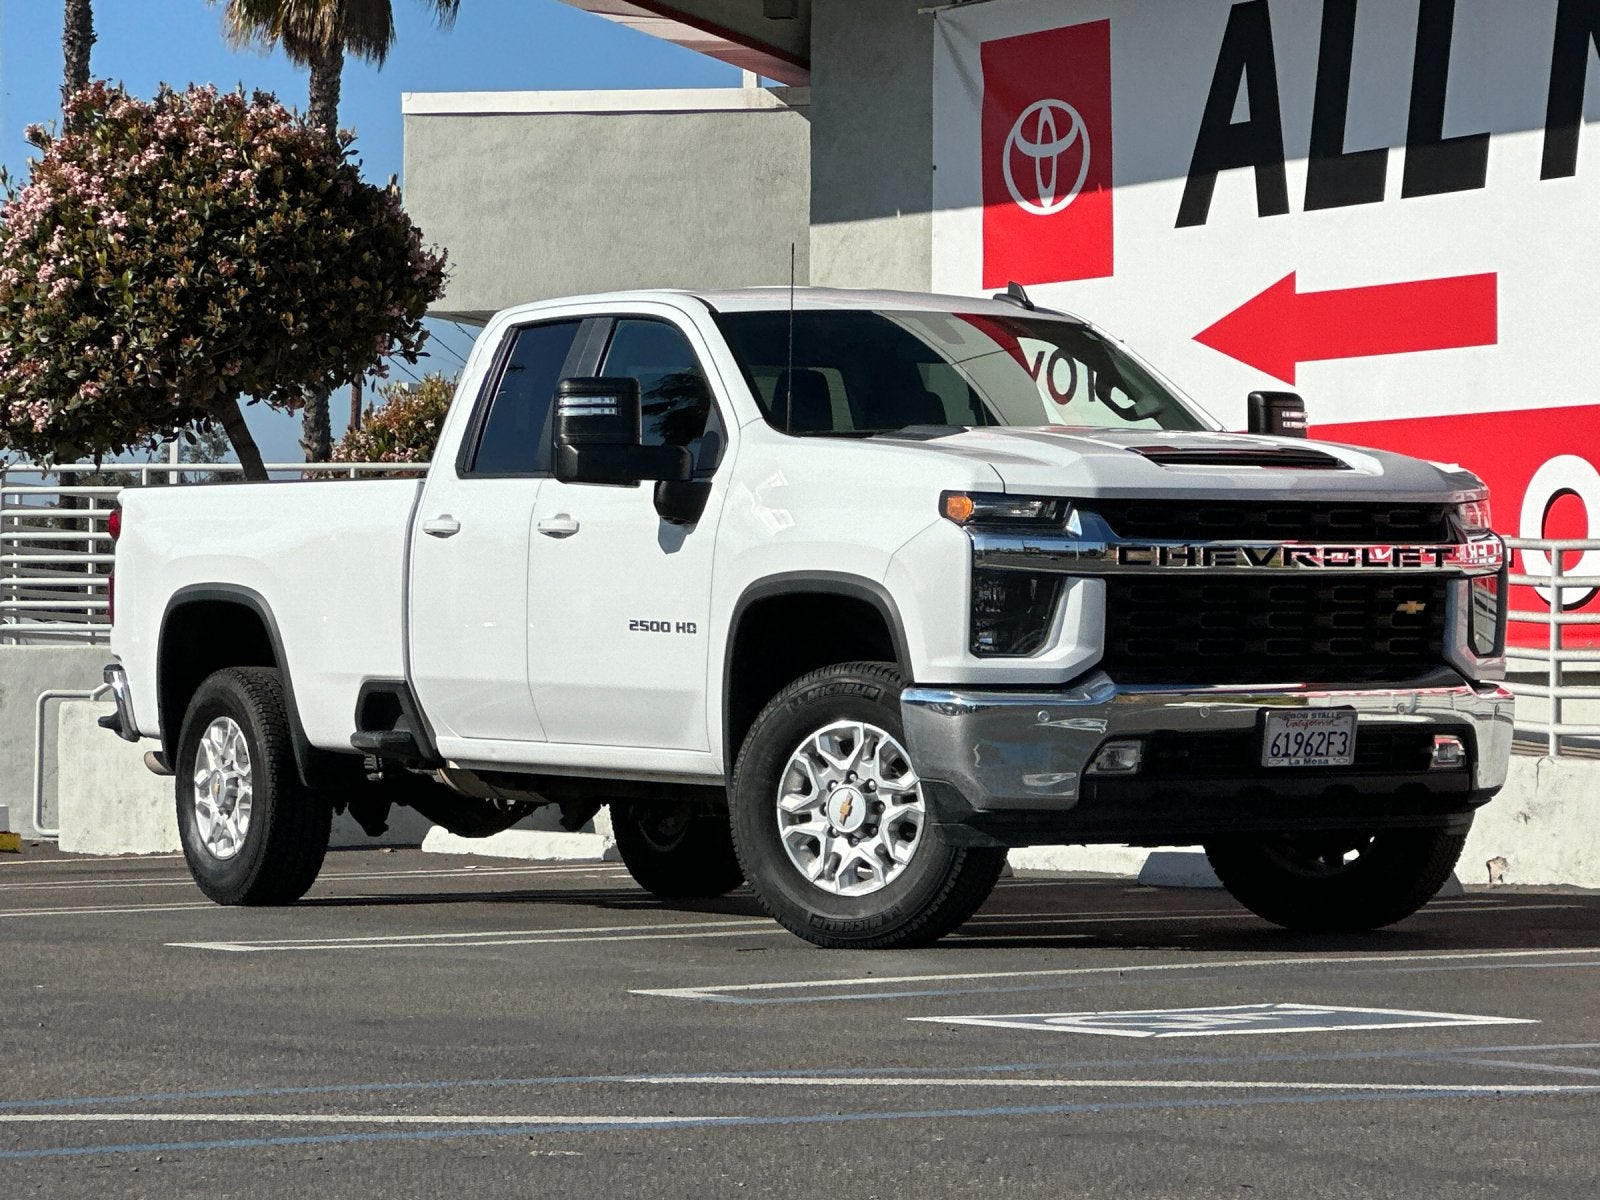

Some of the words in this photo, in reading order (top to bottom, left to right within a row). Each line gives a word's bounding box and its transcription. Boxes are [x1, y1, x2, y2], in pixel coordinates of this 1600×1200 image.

[1174, 0, 1491, 229] ALL
[1116, 545, 1454, 568] CHEVROLET
[629, 620, 671, 633] 2500
[676, 622, 697, 634] HD
[807, 684, 880, 702] MICHELIN
[1283, 718, 1339, 730] California
[1270, 731, 1348, 757] 61962F3
[1288, 757, 1300, 765] La
[1303, 757, 1329, 765] Mesa
